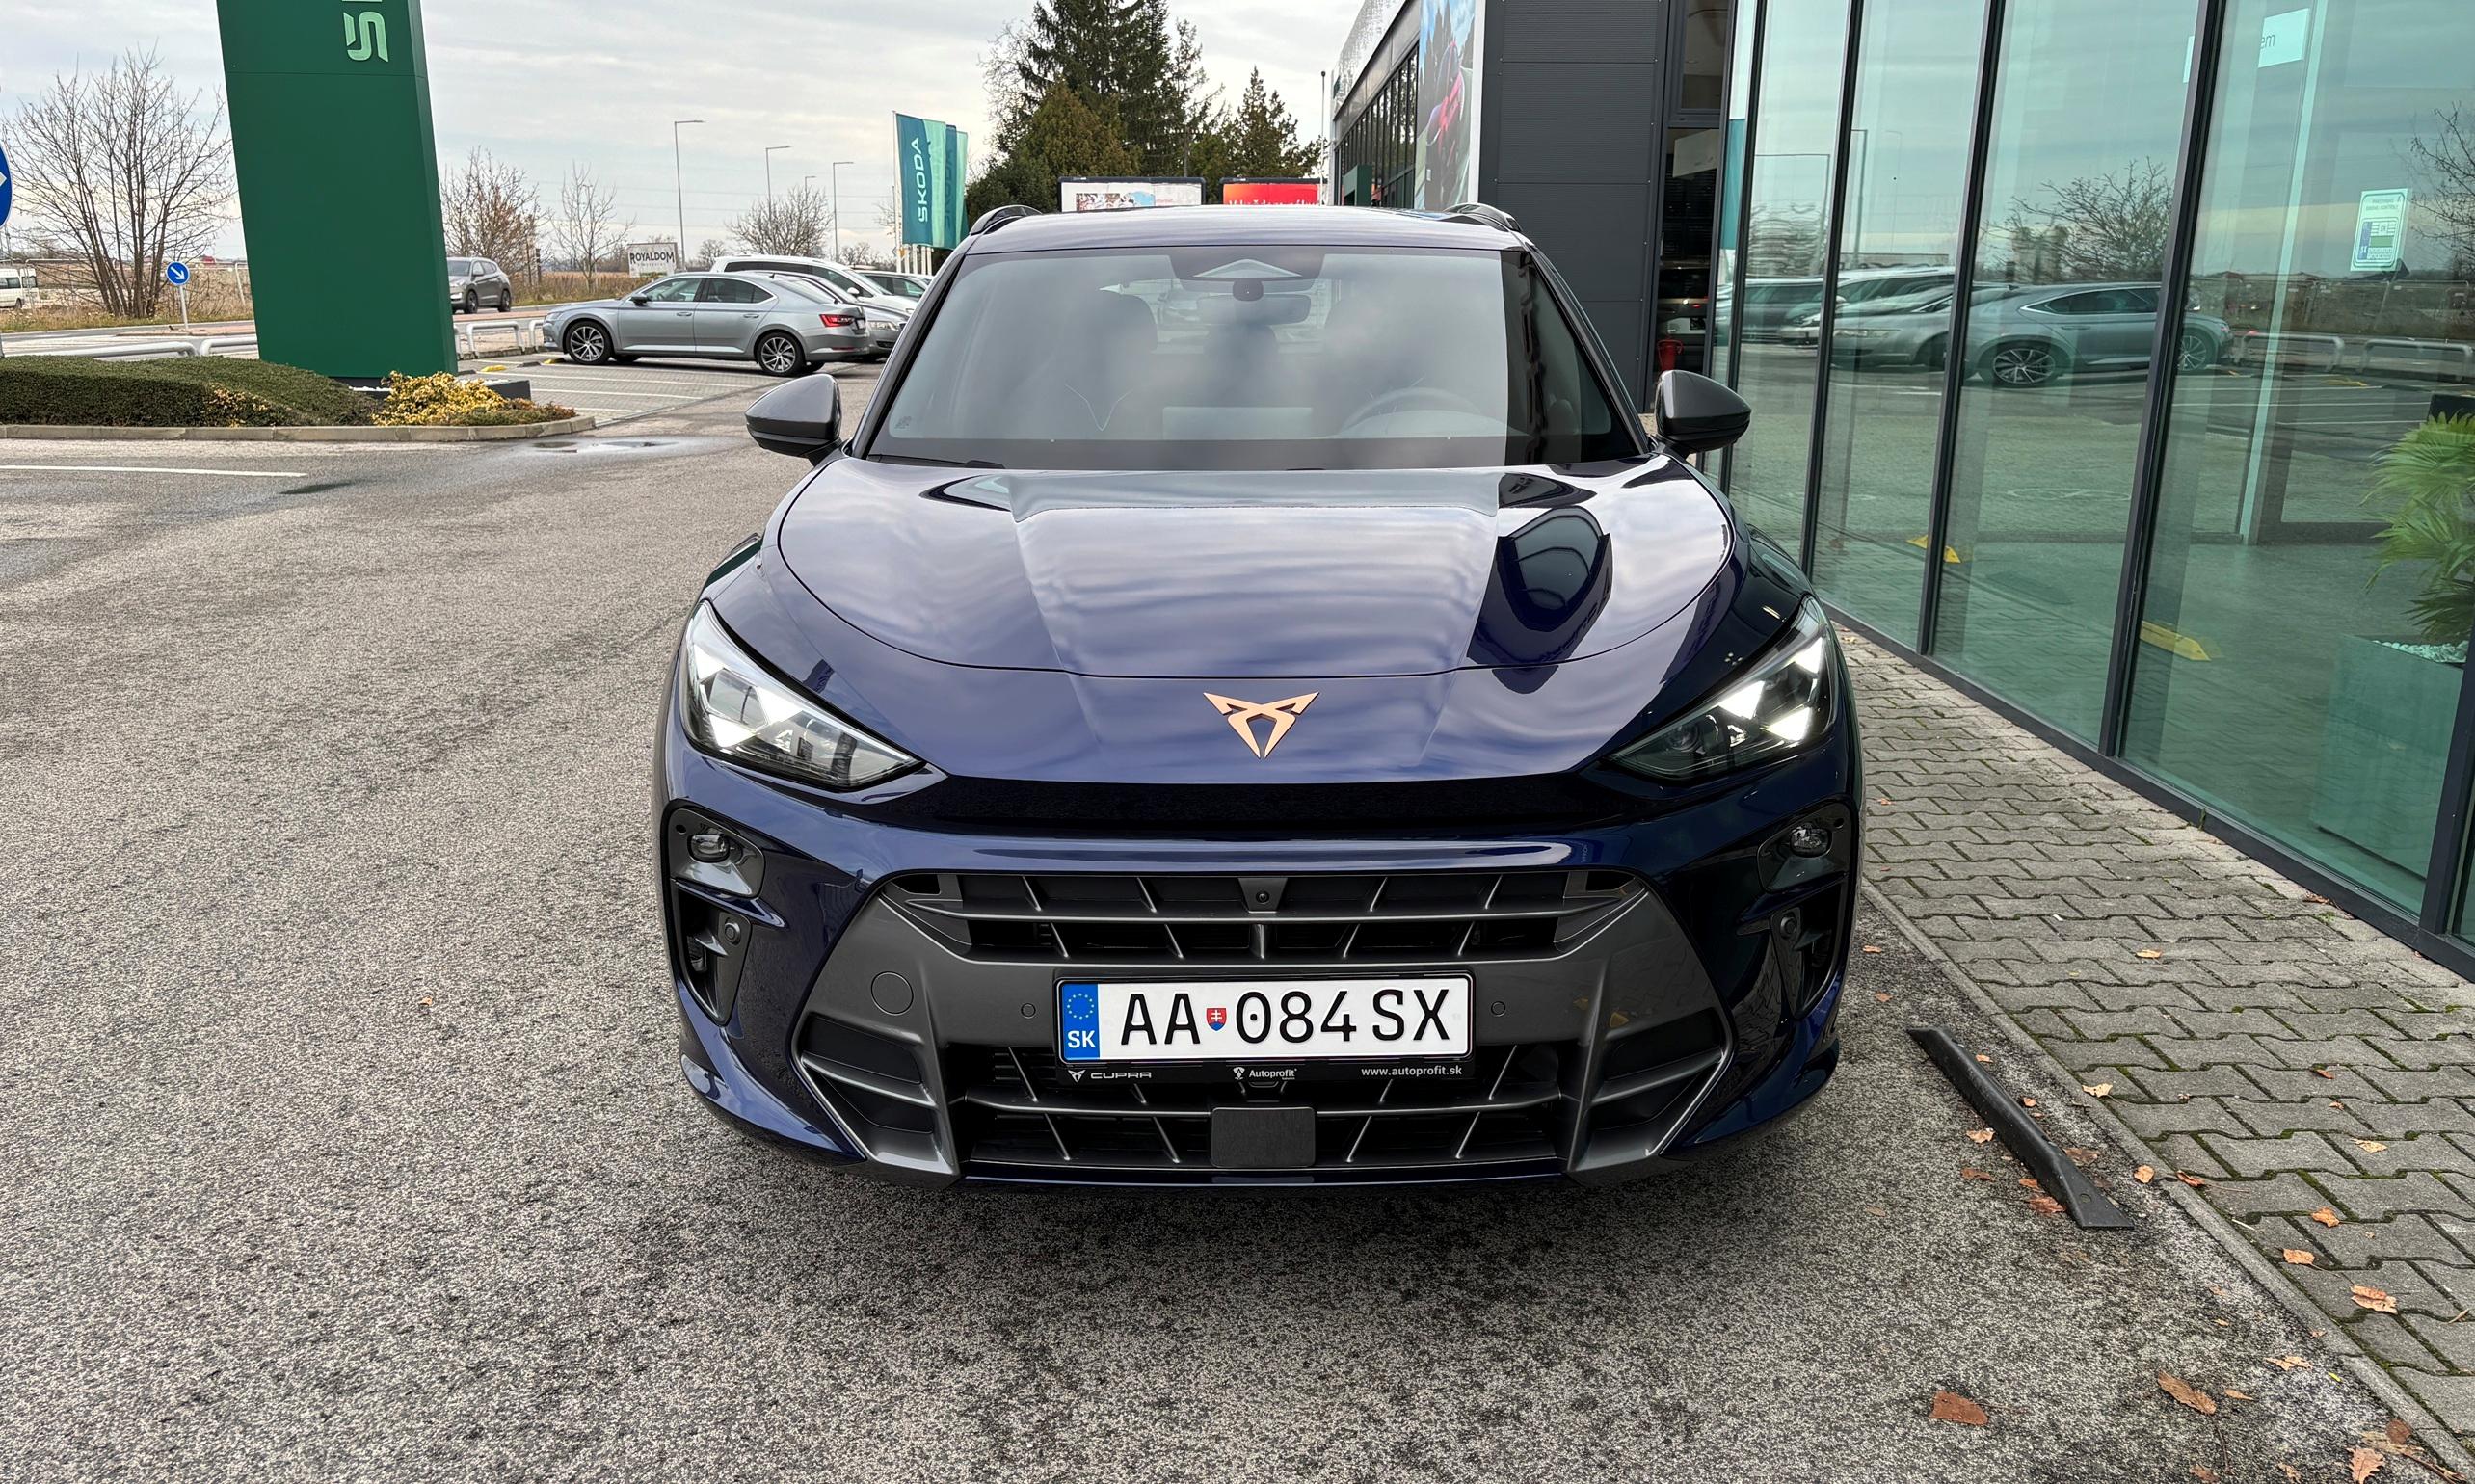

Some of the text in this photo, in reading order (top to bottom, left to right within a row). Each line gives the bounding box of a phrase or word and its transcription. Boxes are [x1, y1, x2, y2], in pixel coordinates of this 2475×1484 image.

[629, 252, 675, 265] ROYALDOM
[1067, 1030, 1096, 1048] SK
[1361, 1065, 1462, 1077] www.autoprofit.sk
